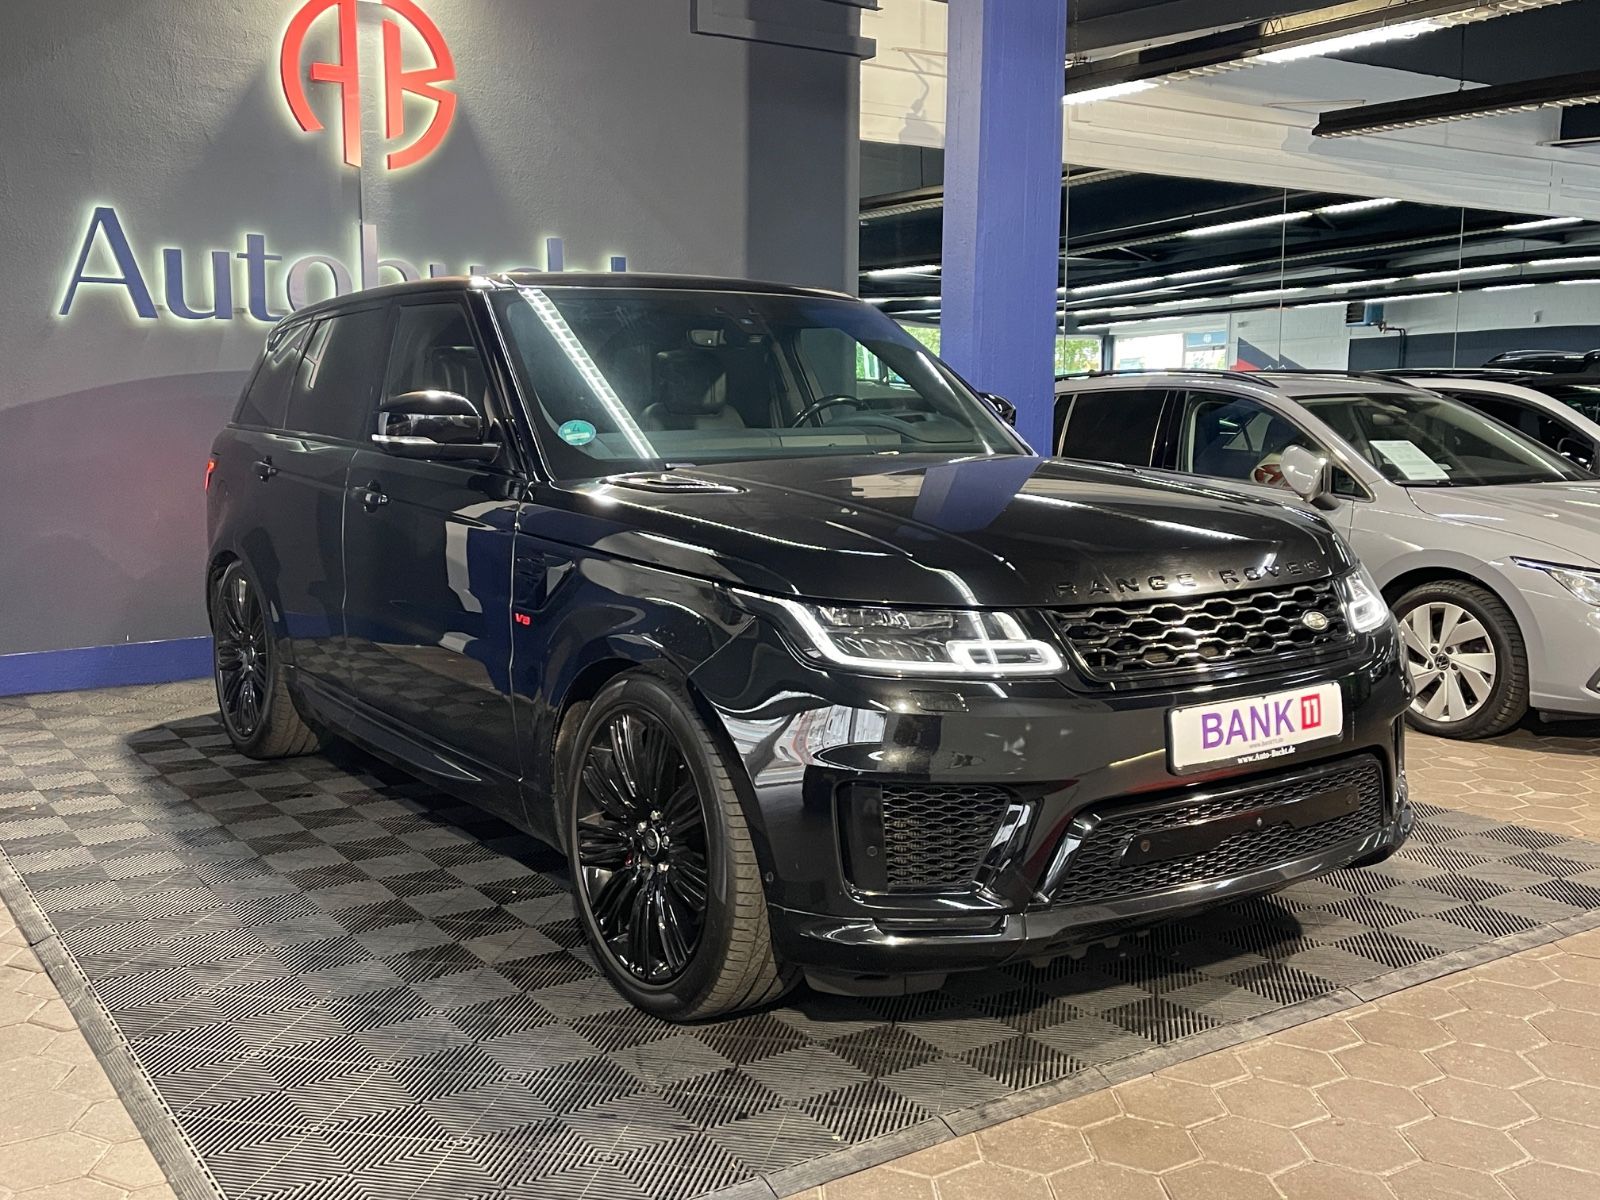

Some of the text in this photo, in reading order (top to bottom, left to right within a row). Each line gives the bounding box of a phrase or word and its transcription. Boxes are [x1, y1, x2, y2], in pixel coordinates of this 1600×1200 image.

[1052, 560, 1321, 597] RANGE ROVER
[1201, 697, 1320, 750] BANK 11
